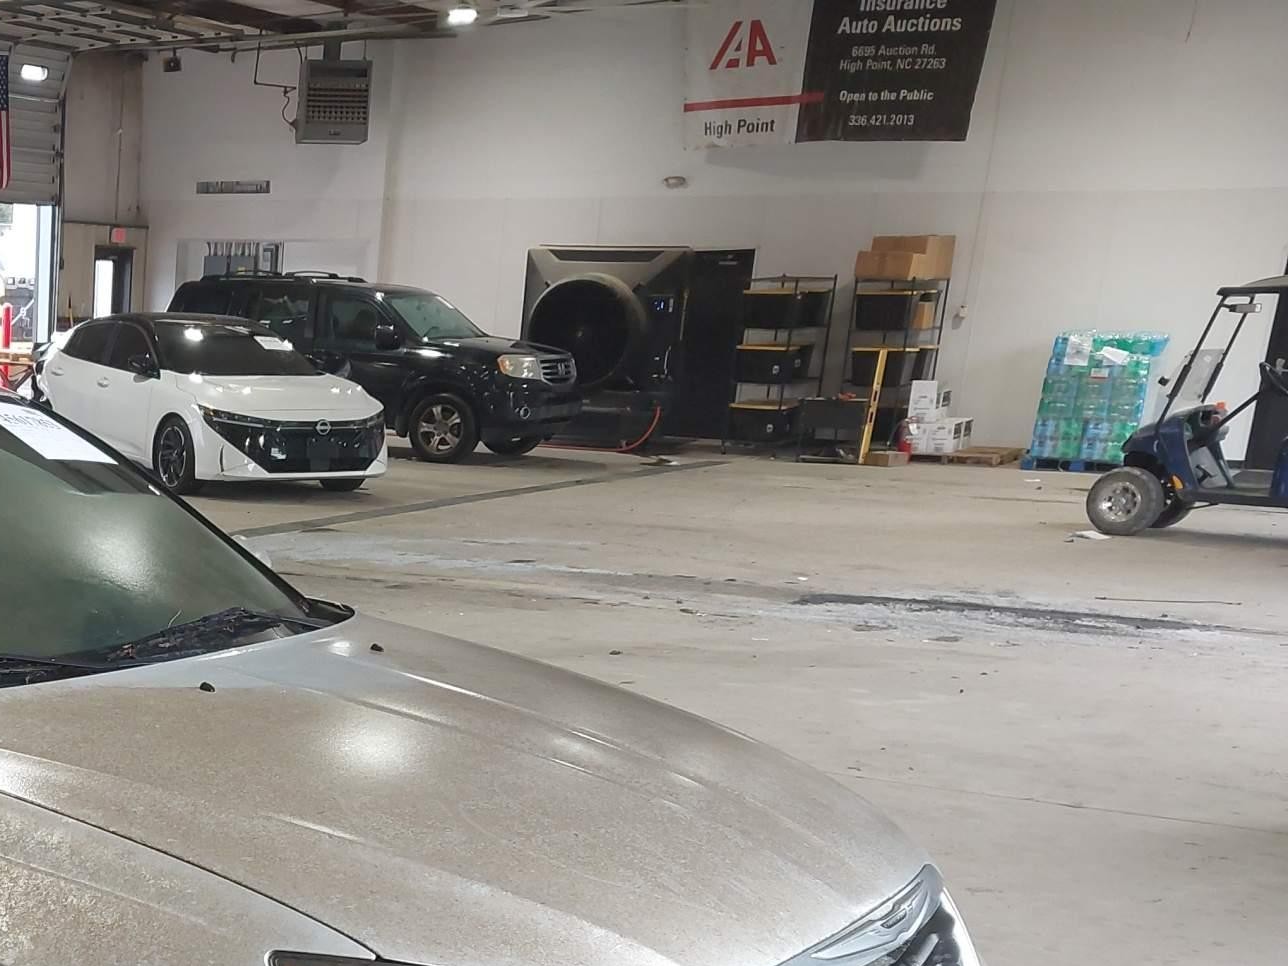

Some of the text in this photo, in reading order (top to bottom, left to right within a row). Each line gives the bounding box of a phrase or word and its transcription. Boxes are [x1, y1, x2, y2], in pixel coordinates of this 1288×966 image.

[859, 0, 948, 11] Insurance
[837, 14, 962, 35] Auto Auctions
[878, 45, 918, 56] Auction
[920, 43, 937, 55] Rd.
[839, 59, 863, 73] High
[896, 58, 913, 70] NC
[914, 57, 947, 70] 27263
[839, 89, 935, 104] Open to the Public
[704, 118, 775, 139] High Point
